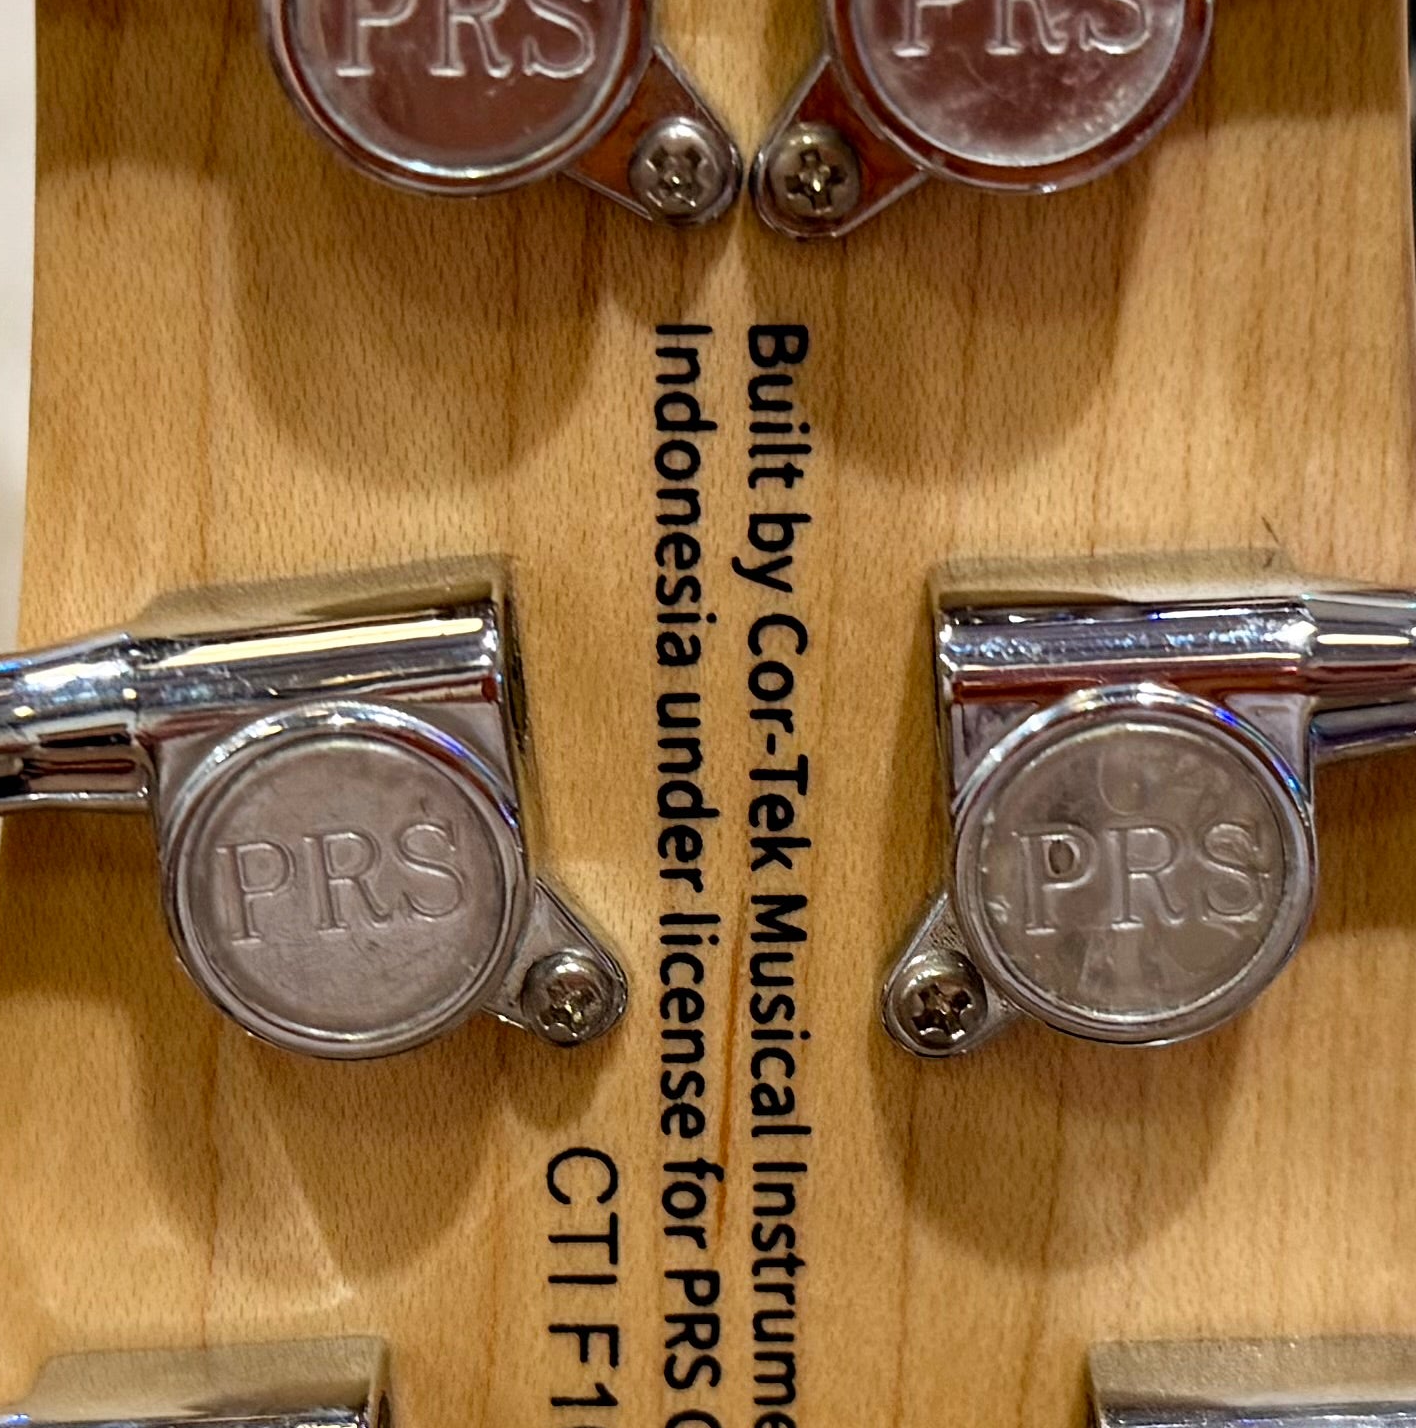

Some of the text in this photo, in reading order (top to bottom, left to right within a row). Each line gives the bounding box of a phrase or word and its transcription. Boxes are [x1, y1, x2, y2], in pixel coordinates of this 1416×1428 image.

[746, 321, 814, 491] Built
[652, 321, 719, 669] Indonesia
[730, 511, 813, 595] by
[655, 691, 722, 895] under
[746, 612, 813, 873] Cor-Tek
[214, 820, 469, 946] PRS
[1013, 821, 1271, 937] PRS
[658, 911, 722, 1141] license
[748, 893, 813, 1139] Musical
[544, 1145, 620, 1287] CTI
[660, 1156, 726, 1251] for
[662, 1268, 723, 1392] PRS
